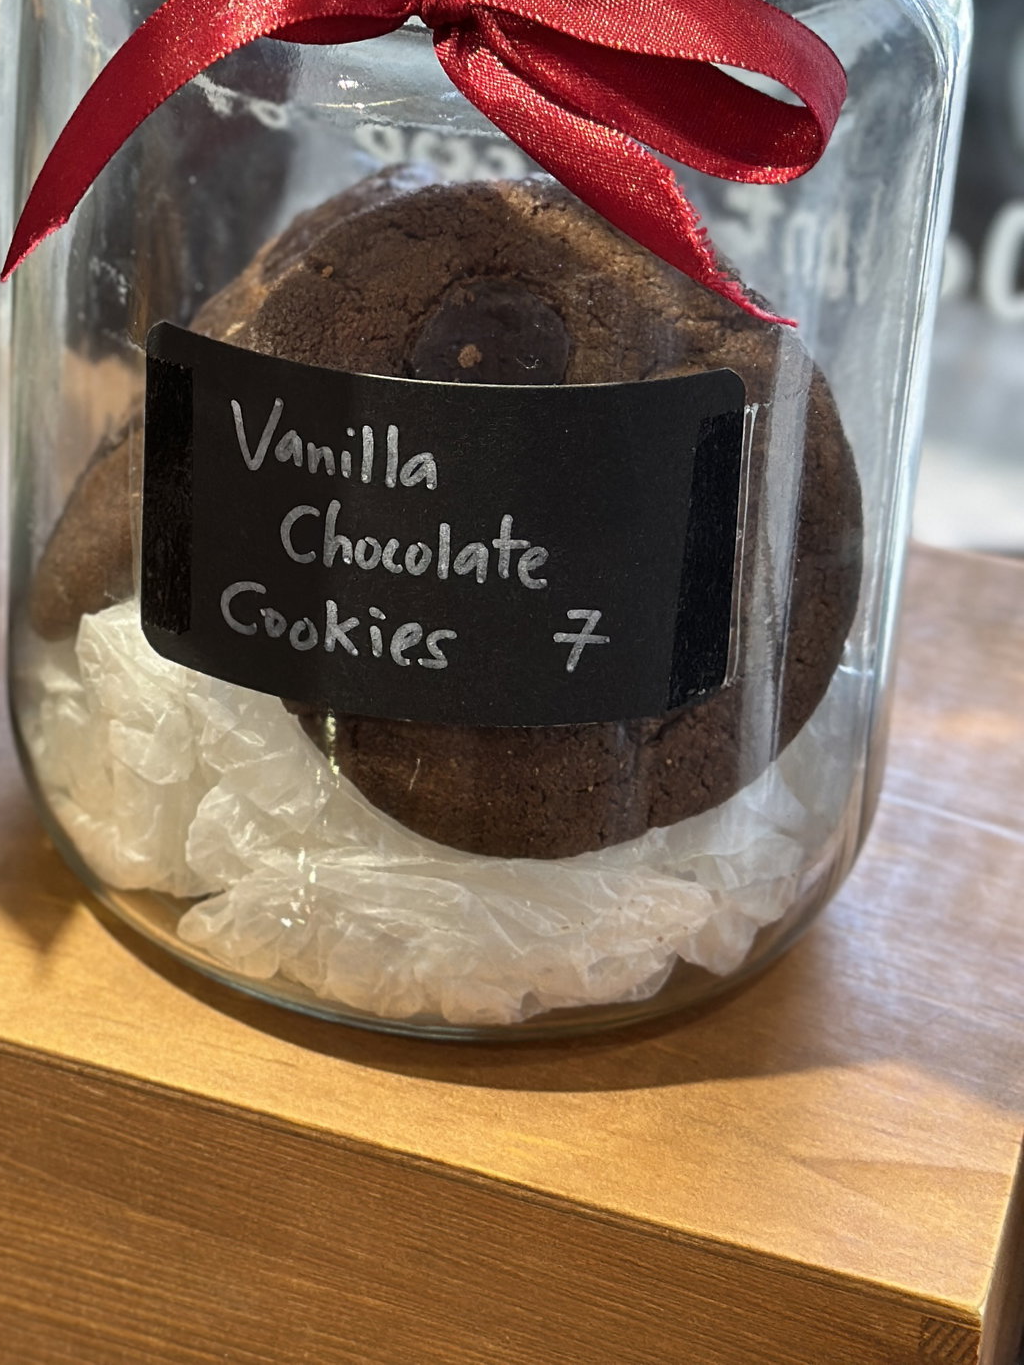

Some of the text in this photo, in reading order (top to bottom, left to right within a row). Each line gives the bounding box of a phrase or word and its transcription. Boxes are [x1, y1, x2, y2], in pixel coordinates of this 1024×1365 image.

[230, 397, 438, 490] Vanilla
[280, 499, 549, 590] Chocolate
[220, 581, 611, 673] Cookies 7
